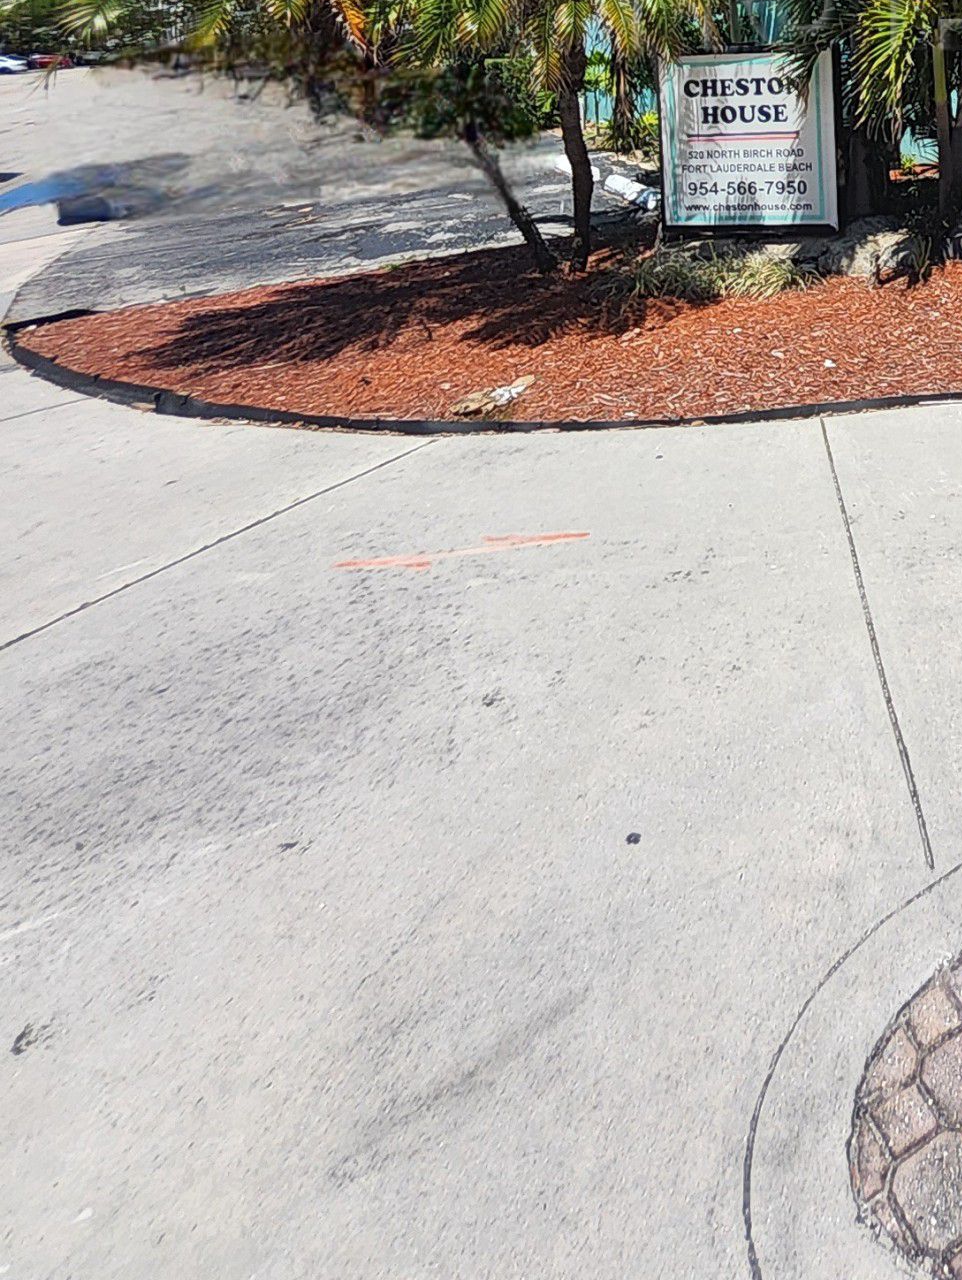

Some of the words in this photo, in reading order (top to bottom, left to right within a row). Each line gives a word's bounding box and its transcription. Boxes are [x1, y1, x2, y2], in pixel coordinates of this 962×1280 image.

[701, 104, 788, 124] HOUSE
[688, 150, 704, 160] 520
[706, 149, 740, 159] NORTH
[743, 148, 773, 158] BIRCH
[776, 148, 804, 158] ROAD
[682, 164, 708, 174] FORT
[710, 163, 776, 173] LAUDERDALE
[778, 162, 813, 172] BEACH
[688, 180, 808, 196] 954-566-7950
[685, 202, 812, 212] www.chestonhouse.com
